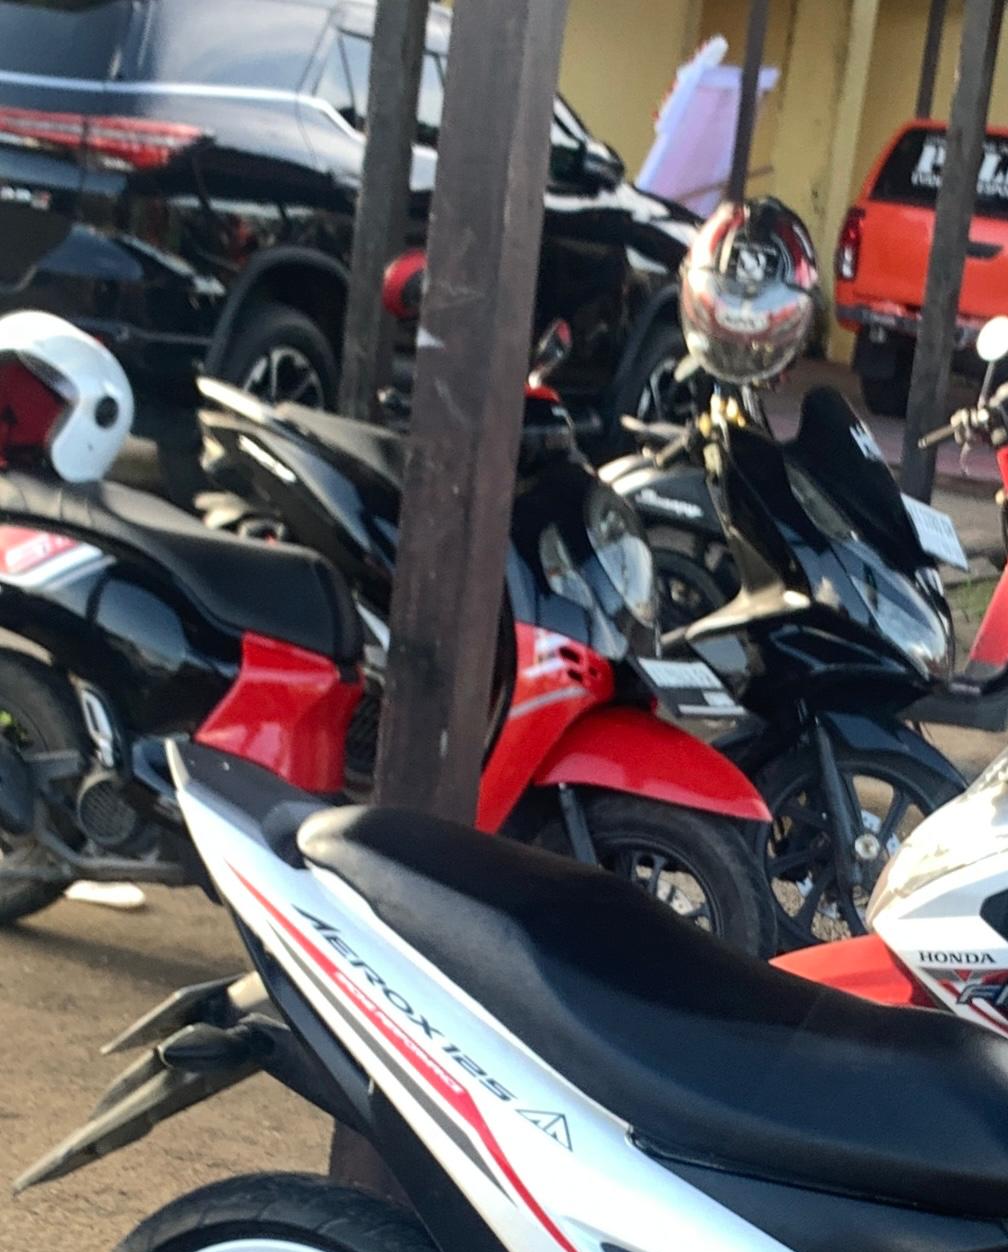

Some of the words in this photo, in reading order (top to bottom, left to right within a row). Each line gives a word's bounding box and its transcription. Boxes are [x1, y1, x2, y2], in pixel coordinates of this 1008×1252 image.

[291, 904, 444, 1039] AEROX
[442, 1044, 517, 1101] 125
[918, 951, 996, 964] HONDA
